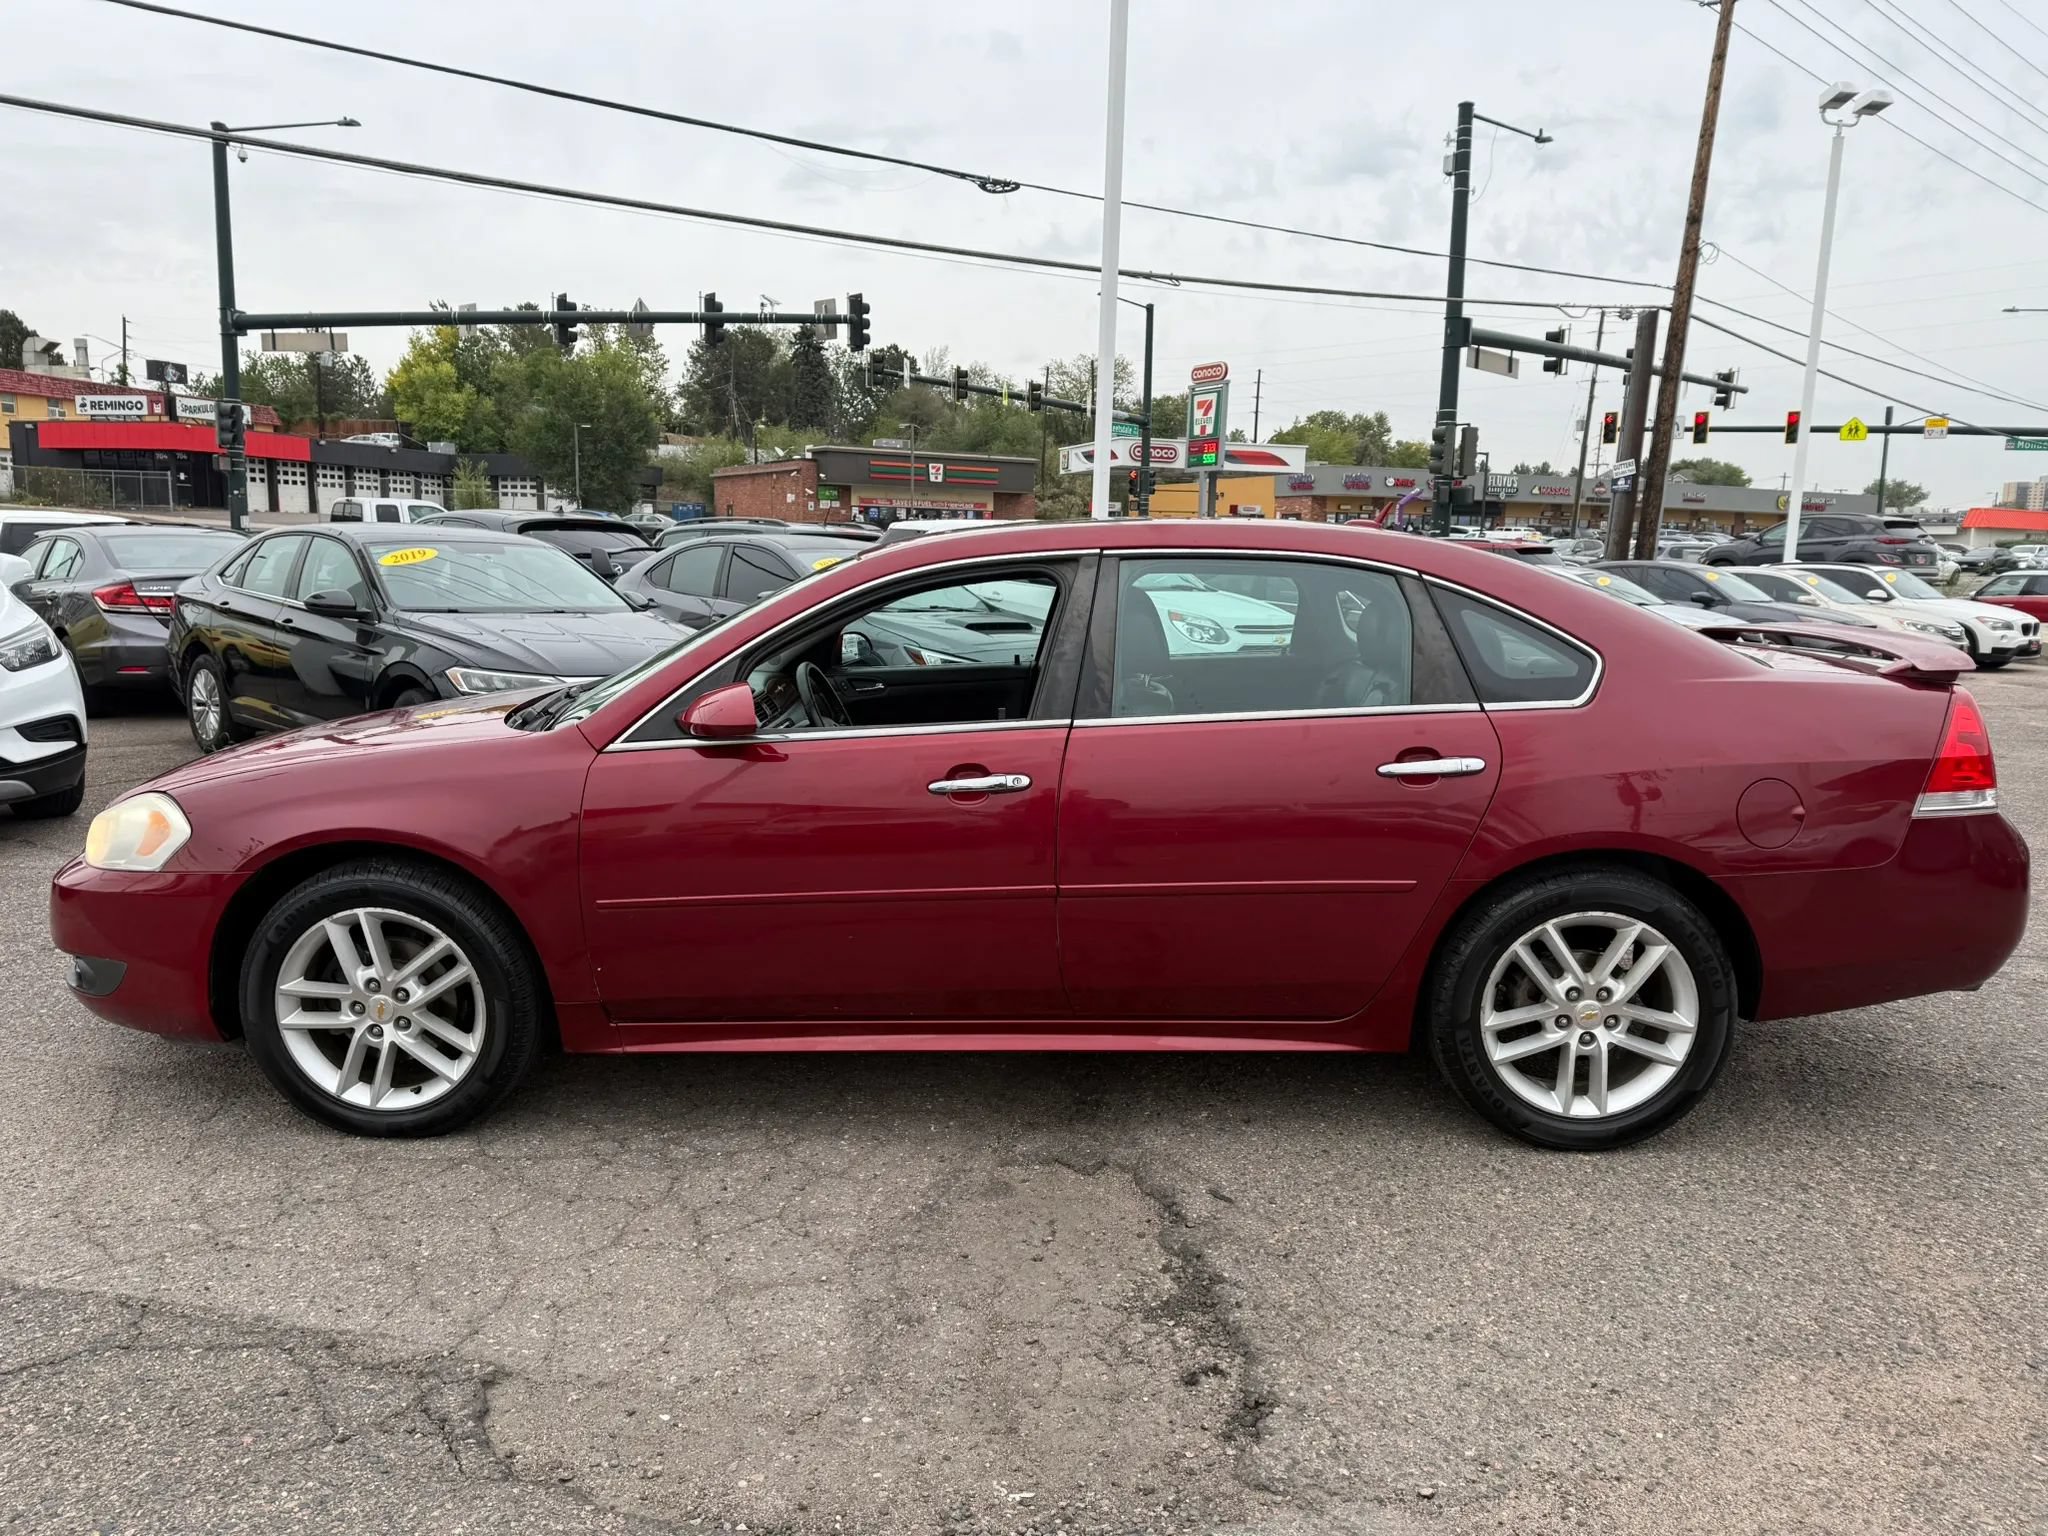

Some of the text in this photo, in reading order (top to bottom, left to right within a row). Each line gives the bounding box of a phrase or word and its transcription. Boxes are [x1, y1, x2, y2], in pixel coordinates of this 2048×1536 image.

[90, 400, 144, 412] REMINGO
[1197, 399, 1213, 417] 7
[390, 549, 427, 564] 2019
